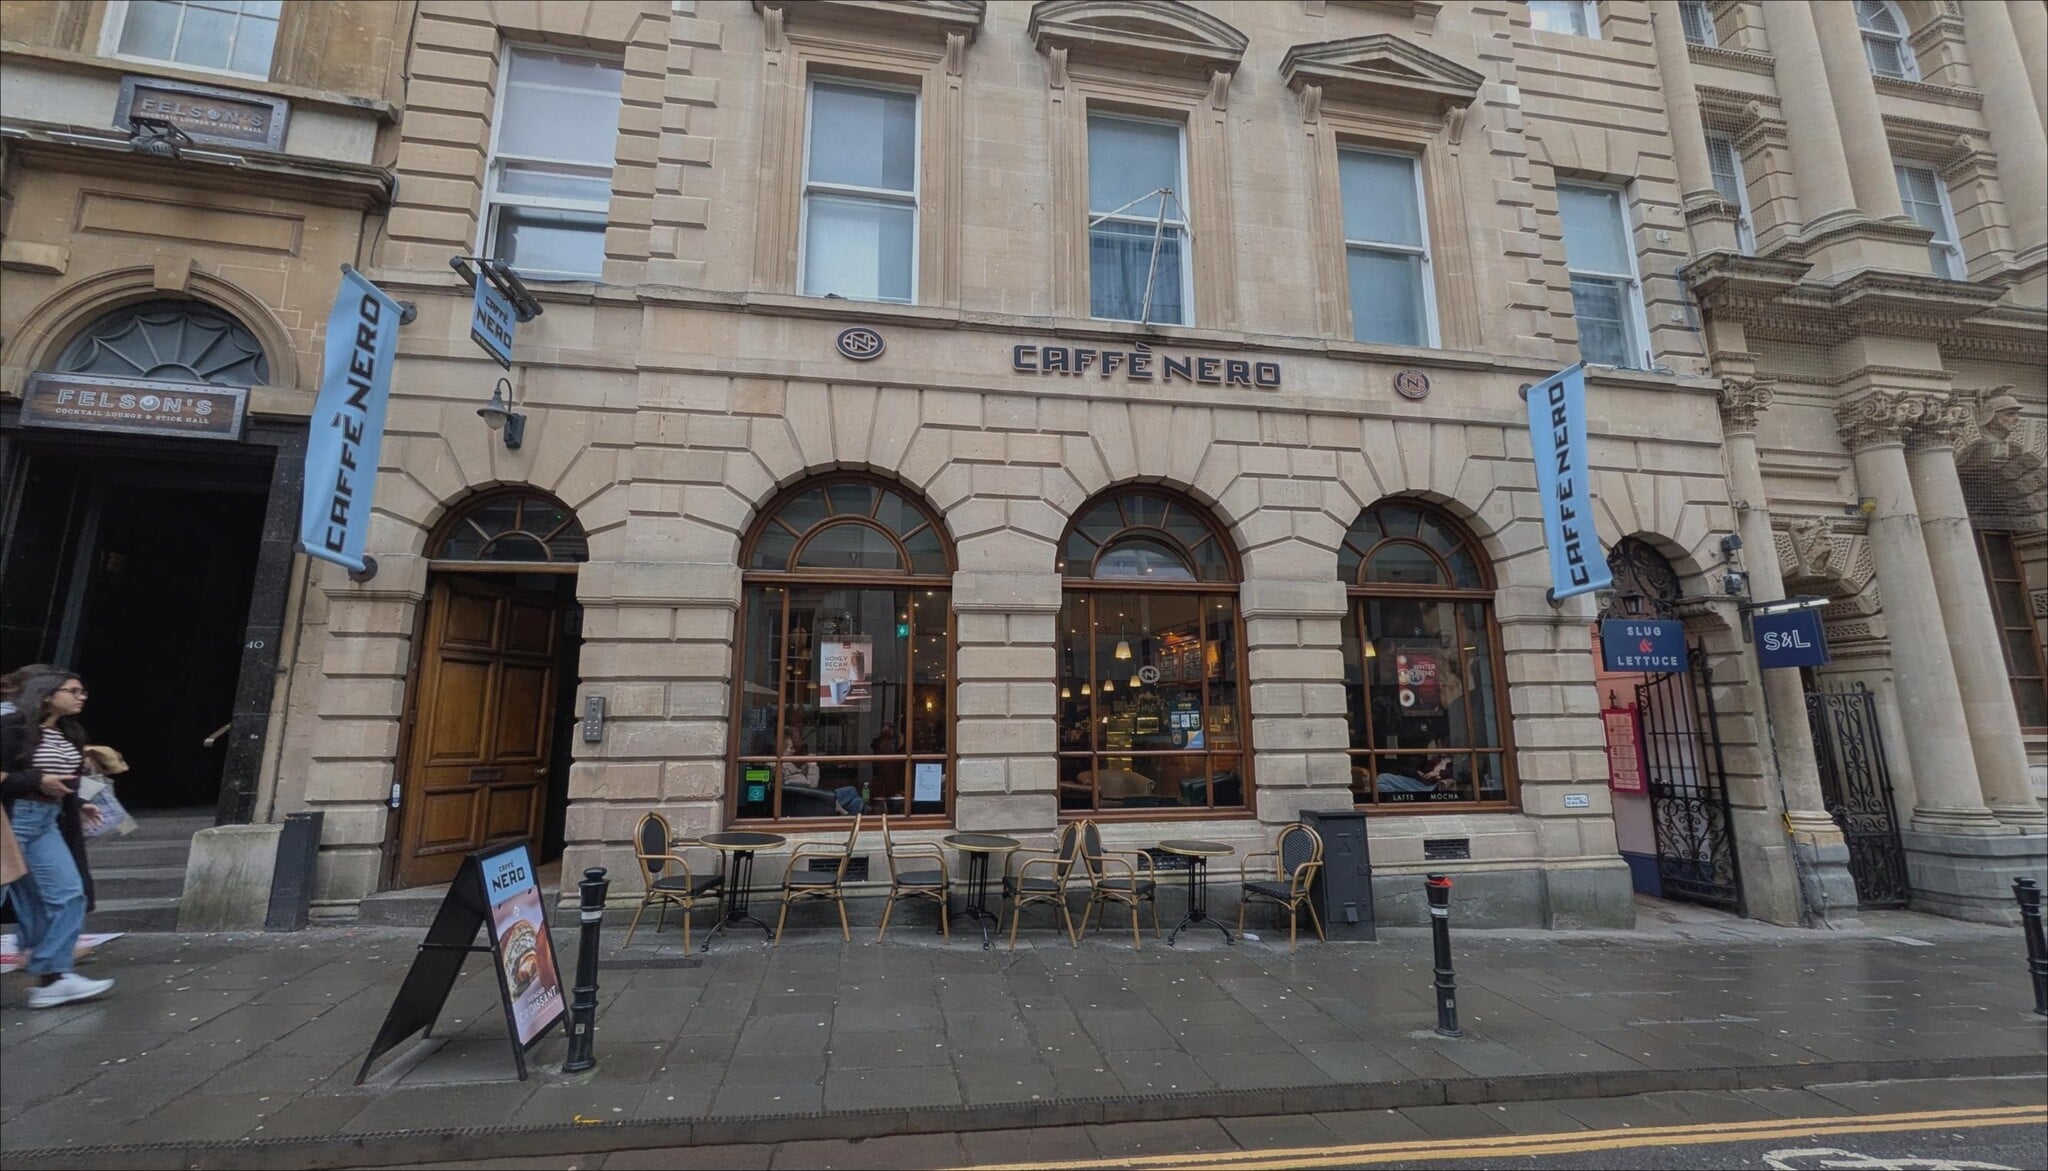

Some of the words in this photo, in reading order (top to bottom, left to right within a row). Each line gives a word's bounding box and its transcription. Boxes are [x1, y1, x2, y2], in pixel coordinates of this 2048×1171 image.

[140, 111, 178, 122] COCKTAIL
[180, 116, 210, 126] LOUNGE
[219, 122, 241, 131] STICK
[243, 126, 263, 134] HALL
[141, 99, 264, 127] FELSON'S
[477, 304, 512, 350] NERO
[344, 293, 381, 413] NERO
[1012, 341, 1153, 379] CAFFÈ
[1162, 352, 1282, 388] NERO
[57, 389, 213, 415] FELSON'S
[55, 407, 103, 417] COCKTAIL
[106, 409, 143, 420] LOUNGE
[185, 417, 210, 425] HALL
[1547, 381, 1572, 477] NERO
[325, 411, 364, 553] CAFFÈ
[1555, 477, 1590, 586] CAFFÈ
[1627, 626, 1662, 636] SLUG
[1763, 629, 1811, 651] S&L
[246, 640, 265, 649] 40
[1639, 639, 1653, 653] &
[1617, 656, 1679, 666] LETTUCE
[492, 866, 526, 892] NERO
